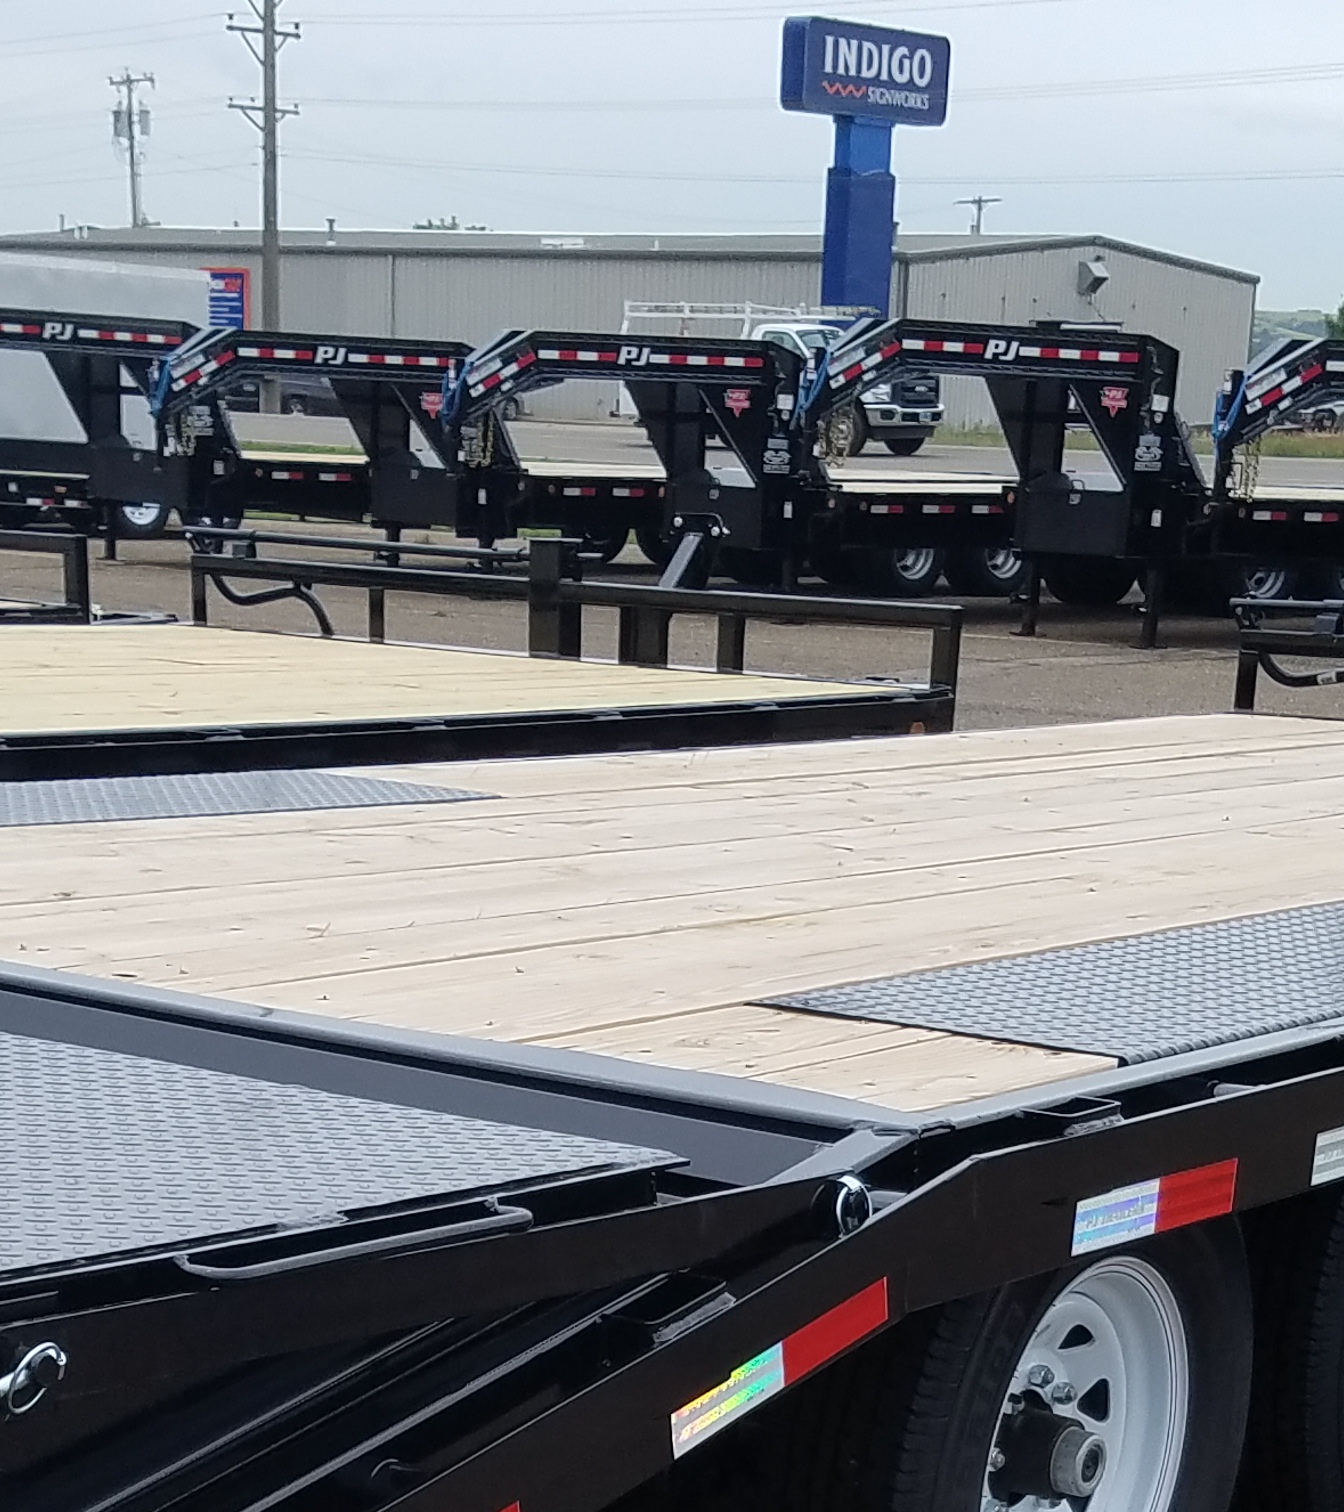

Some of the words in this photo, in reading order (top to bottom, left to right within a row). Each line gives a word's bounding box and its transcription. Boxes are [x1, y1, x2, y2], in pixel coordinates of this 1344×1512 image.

[823, 34, 932, 88] INDIGO
[42, 322, 74, 340] PJ
[314, 346, 348, 365] PJ
[617, 346, 651, 366] PJ
[984, 339, 1020, 361] PJ
